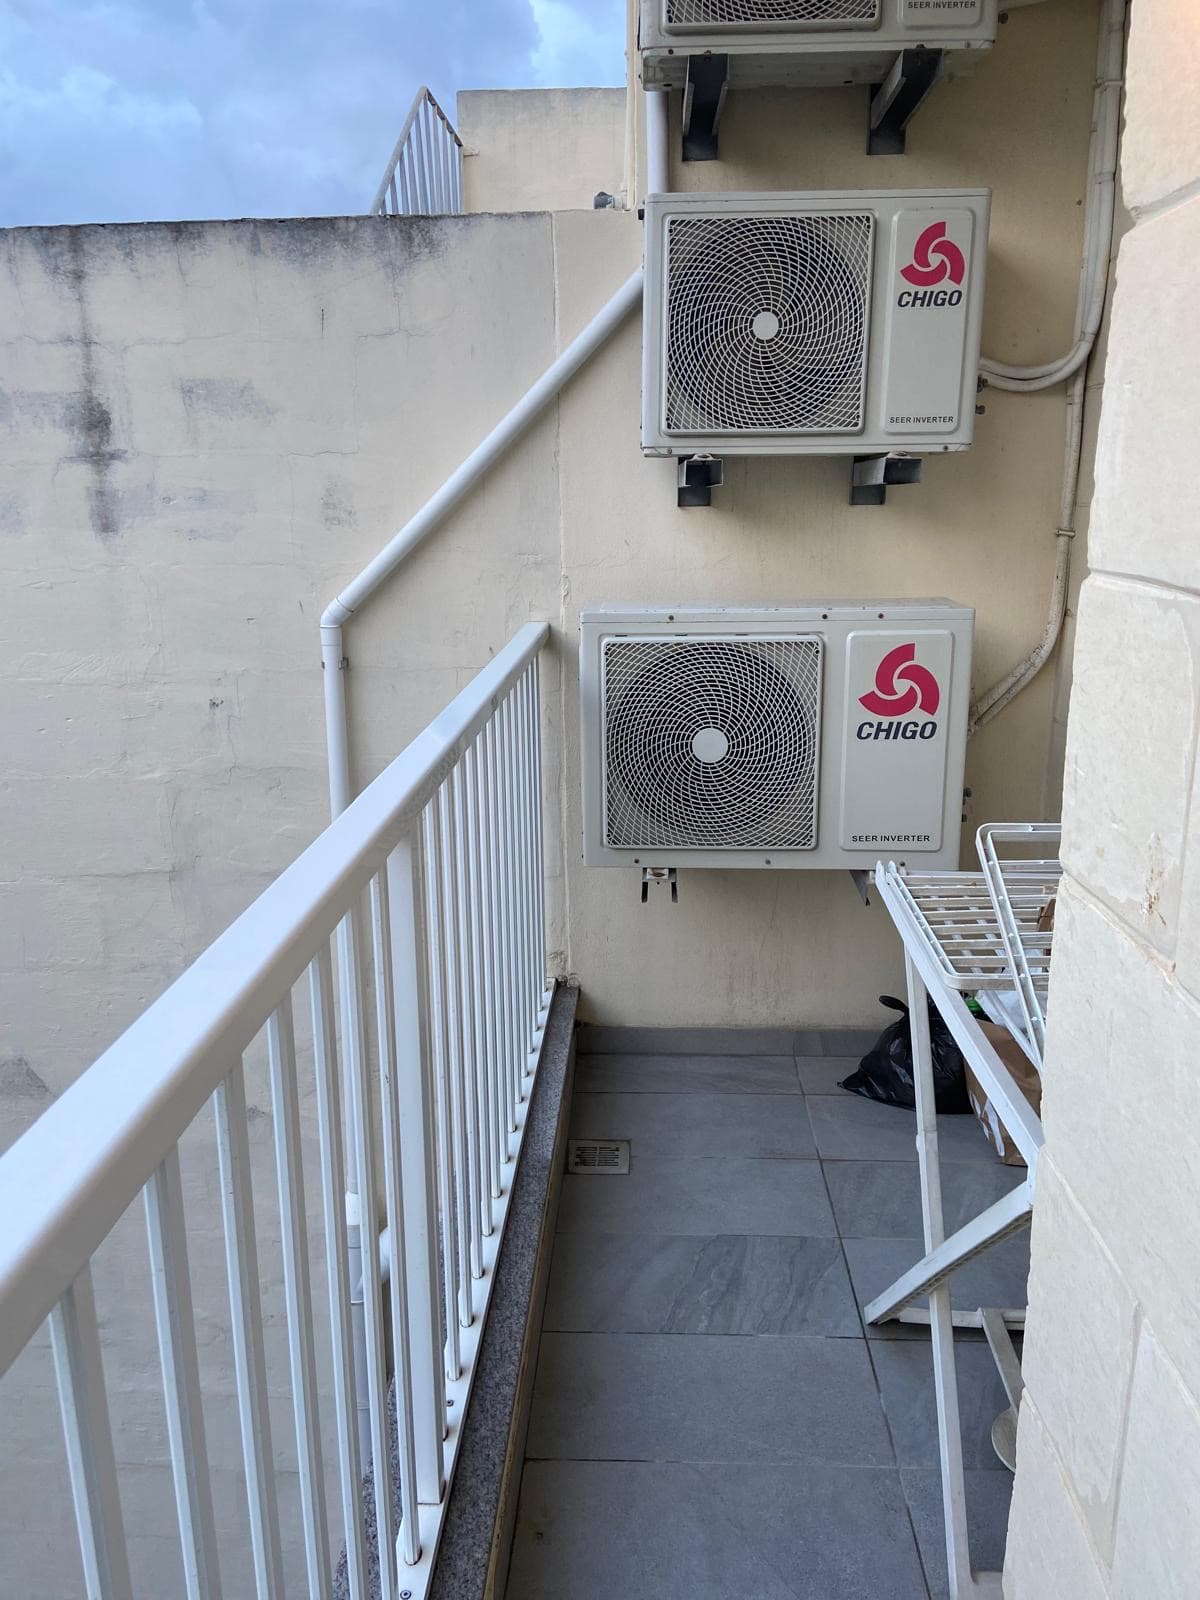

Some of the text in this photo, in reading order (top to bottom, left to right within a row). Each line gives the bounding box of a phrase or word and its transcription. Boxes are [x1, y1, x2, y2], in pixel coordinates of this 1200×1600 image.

[908, 1, 977, 9] SEER INVERTER
[897, 290, 963, 308] CHIGO
[889, 416, 954, 424] SEER INVERTER
[856, 721, 938, 740] CHIGO
[880, 834, 930, 842] INVERTER
